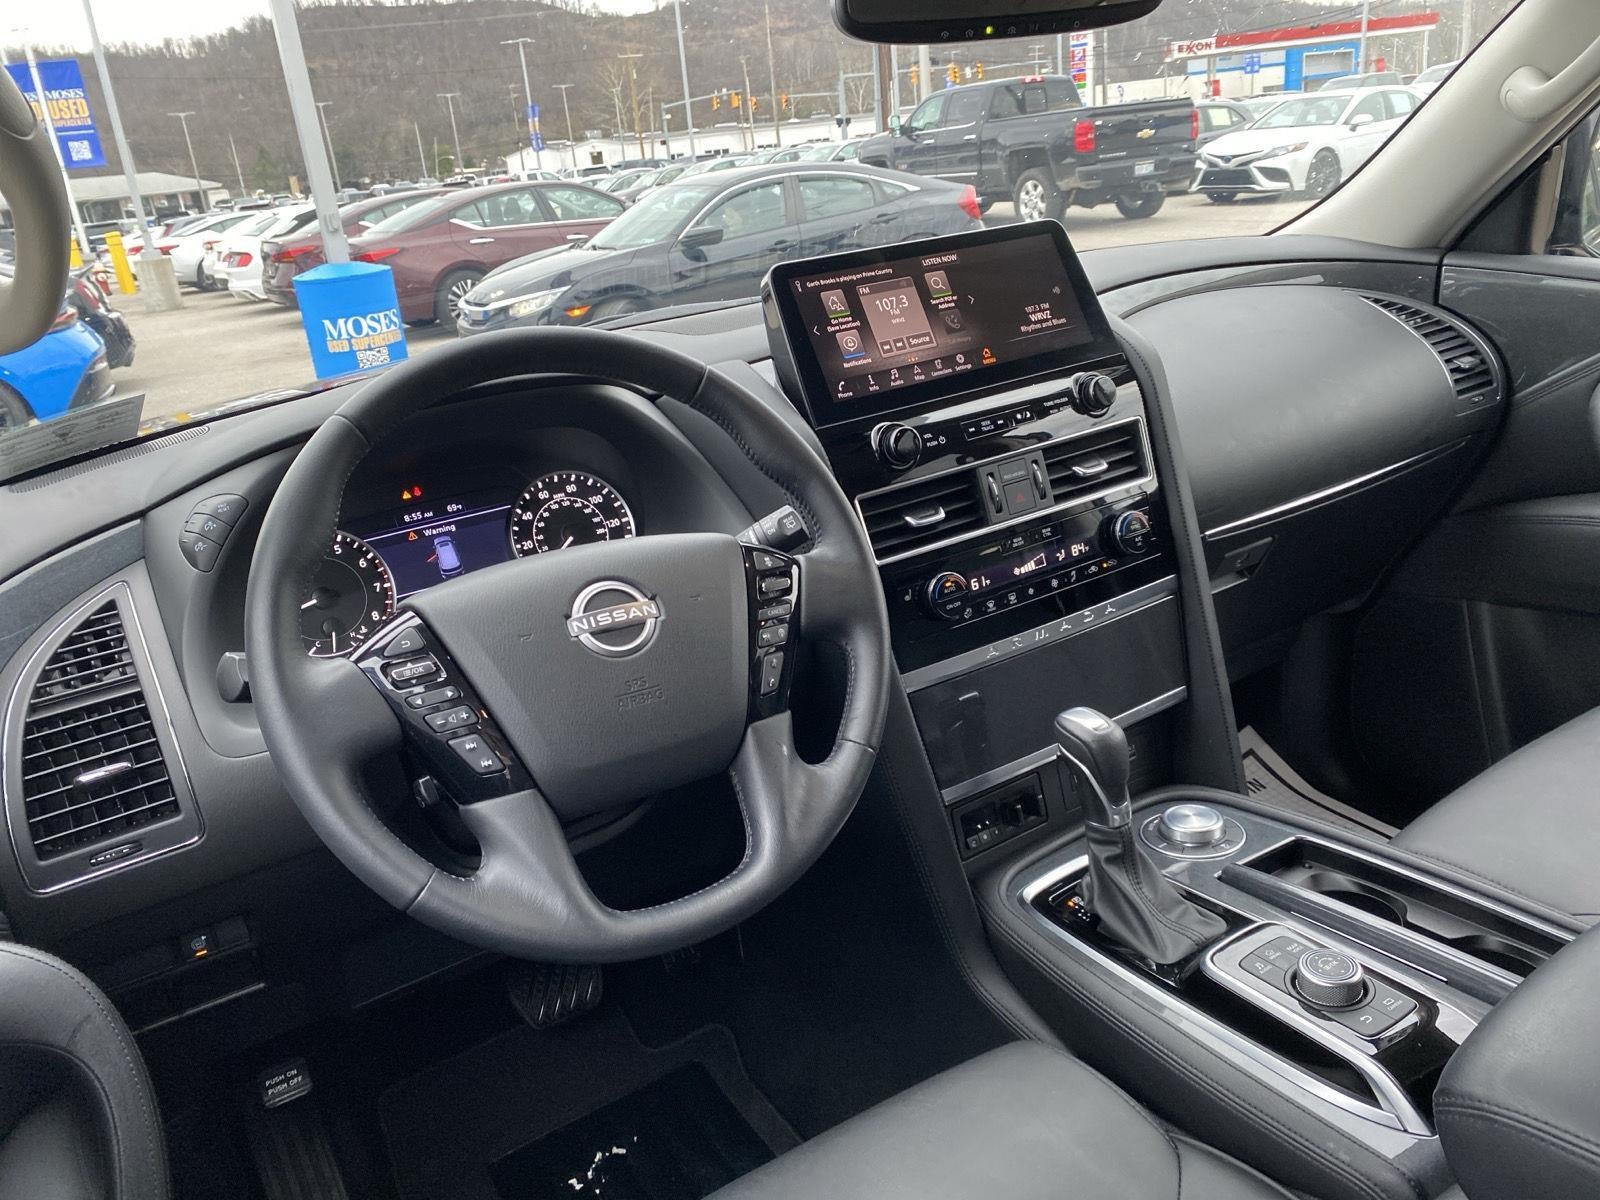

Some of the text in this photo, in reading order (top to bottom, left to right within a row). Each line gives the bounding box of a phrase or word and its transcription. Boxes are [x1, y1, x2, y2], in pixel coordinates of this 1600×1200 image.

[1177, 41, 1212, 54] EXXON
[45, 88, 84, 99] MOSES
[47, 98, 89, 119] USED
[922, 254, 957, 266] LISTEN NOW
[859, 286, 870, 295] FM
[875, 295, 909, 312] 107.3
[1025, 302, 1050, 313] 107.3 FM
[890, 308, 900, 316] FM
[1029, 310, 1052, 322] WRVZ
[322, 308, 400, 341] MOSES
[1020, 317, 1067, 333] Rhythm and Blues
[909, 336, 930, 345] Source
[843, 358, 872, 368] Notifications
[954, 363, 972, 372] Settings
[838, 391, 853, 399] Phone
[565, 484, 577, 493] 80
[538, 491, 549, 499] 60
[588, 494, 603, 504] 100
[403, 512, 422, 522] 8:55
[521, 512, 533, 521] 40
[606, 518, 620, 528] 120
[422, 524, 456, 537] Warning
[333, 544, 342, 555] 5
[521, 540, 534, 550] 20
[358, 558, 367, 568] 6
[373, 582, 381, 593] 7
[944, 586, 956, 594] AUTO
[371, 610, 379, 621] 8
[571, 603, 657, 633] NISSAN
[624, 676, 649, 692] SRS
[618, 688, 664, 711] AIRBAG
[265, 1069, 298, 1088] PUSH ON
[267, 1075, 303, 1095] PUSH OFF
